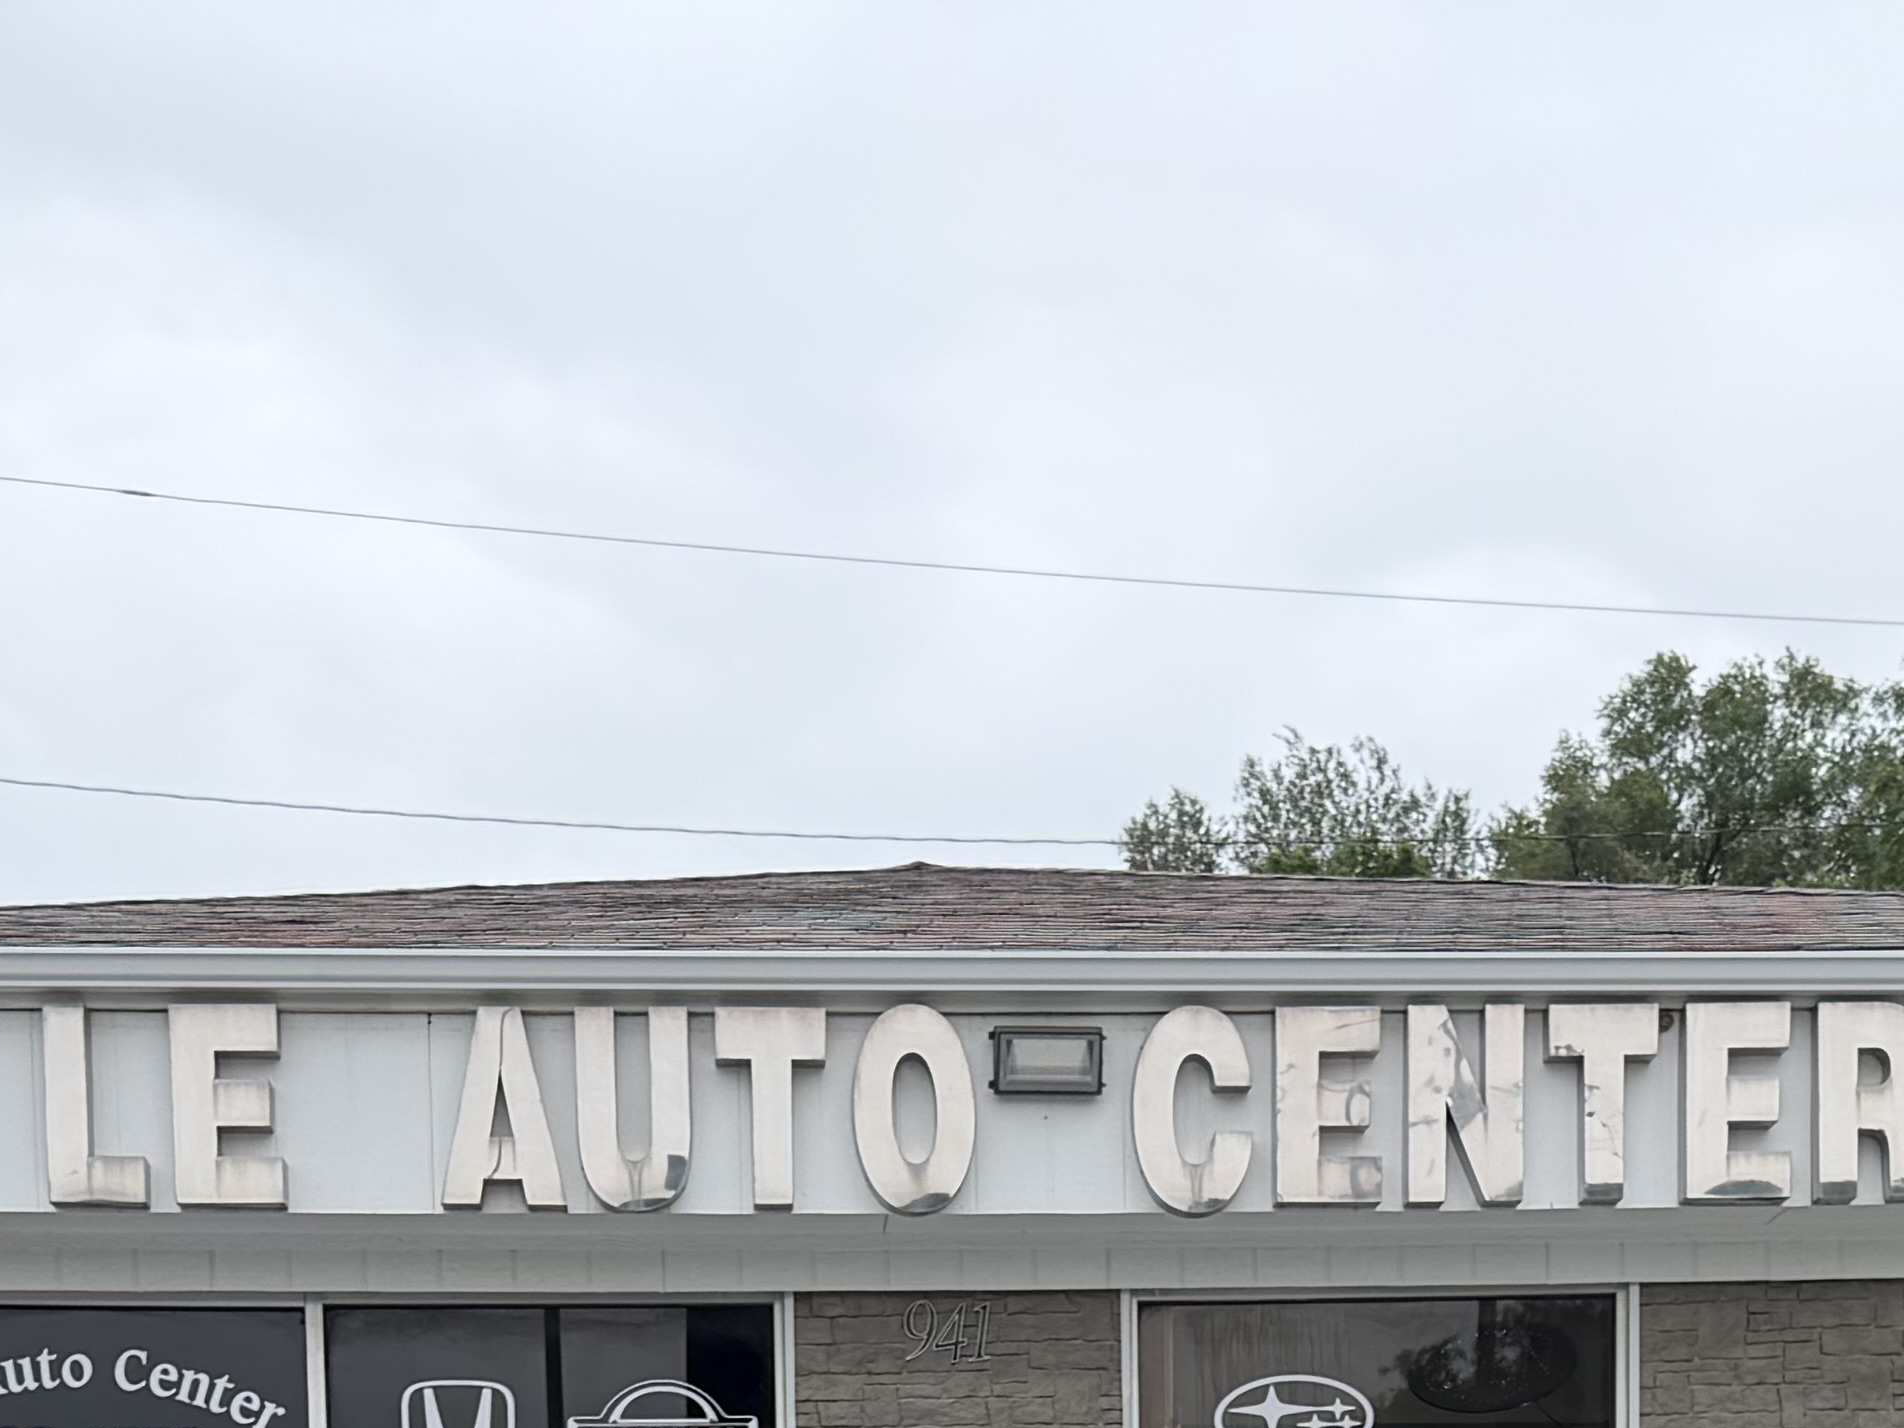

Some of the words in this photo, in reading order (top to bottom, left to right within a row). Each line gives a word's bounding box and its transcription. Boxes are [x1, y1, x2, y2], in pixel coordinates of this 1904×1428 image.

[42, 1002, 288, 1211] LE
[442, 1002, 977, 1215] AUTO
[903, 1299, 992, 1364] 941
